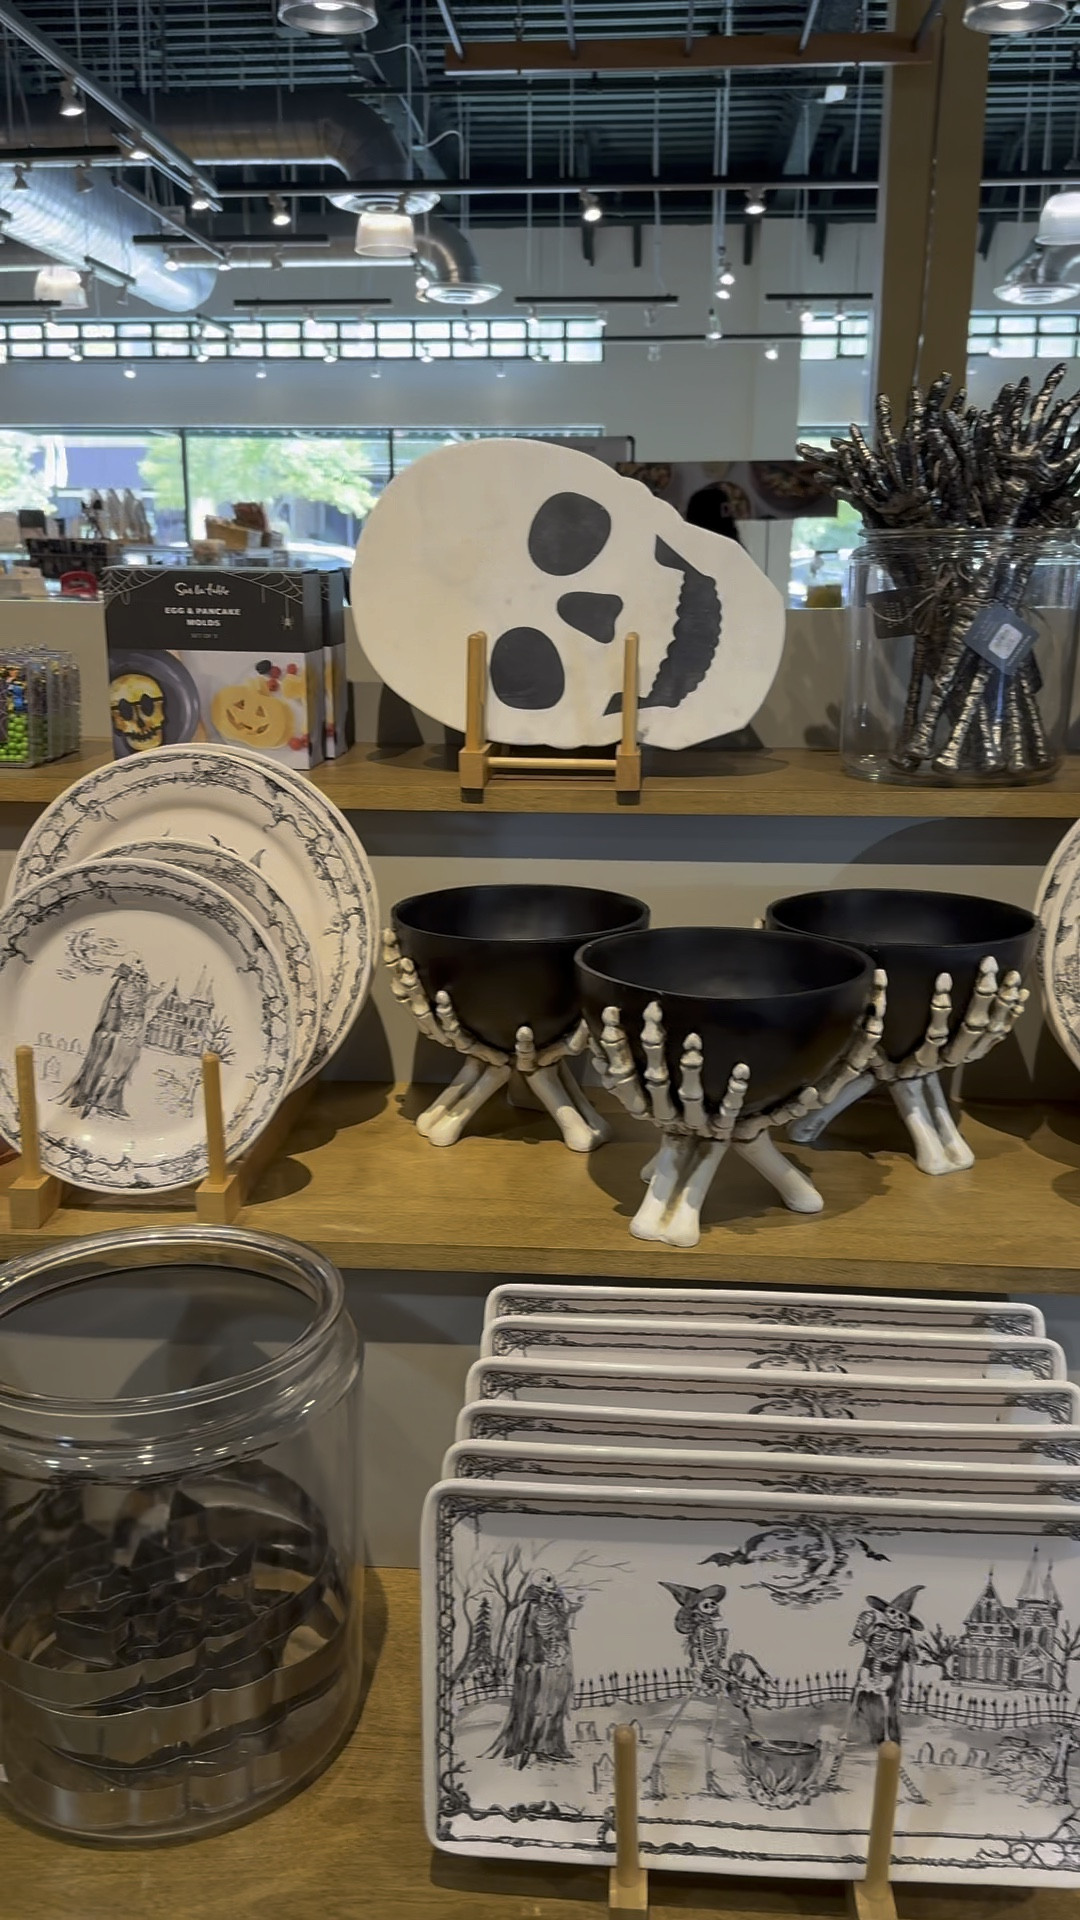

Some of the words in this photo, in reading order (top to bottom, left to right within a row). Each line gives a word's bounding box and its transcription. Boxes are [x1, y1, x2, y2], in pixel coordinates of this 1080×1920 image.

[187, 607, 194, 615] &
[195, 607, 242, 616] PANCAKE
[186, 619, 221, 627] MOLDS
